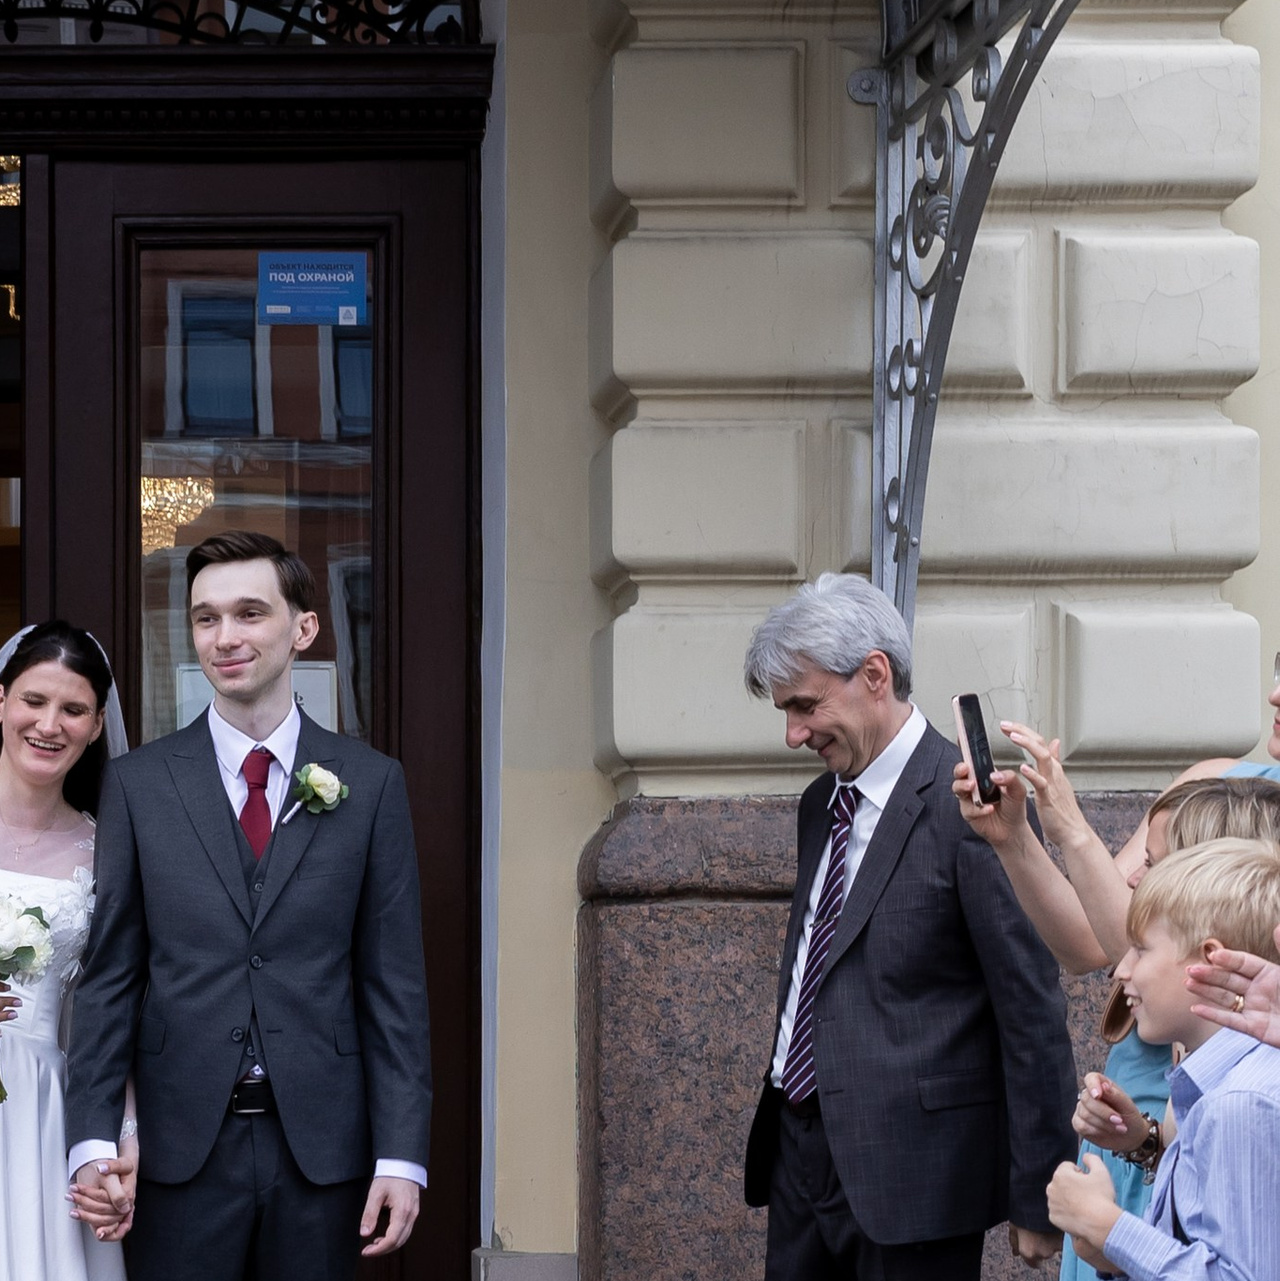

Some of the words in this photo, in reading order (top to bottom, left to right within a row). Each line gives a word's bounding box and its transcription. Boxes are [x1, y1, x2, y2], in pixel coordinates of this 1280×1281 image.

[304, 263, 354, 271] НАХОДИТСЯ
[269, 272, 295, 283] ПОД
[298, 271, 354, 282] ОХРАНОЙ
